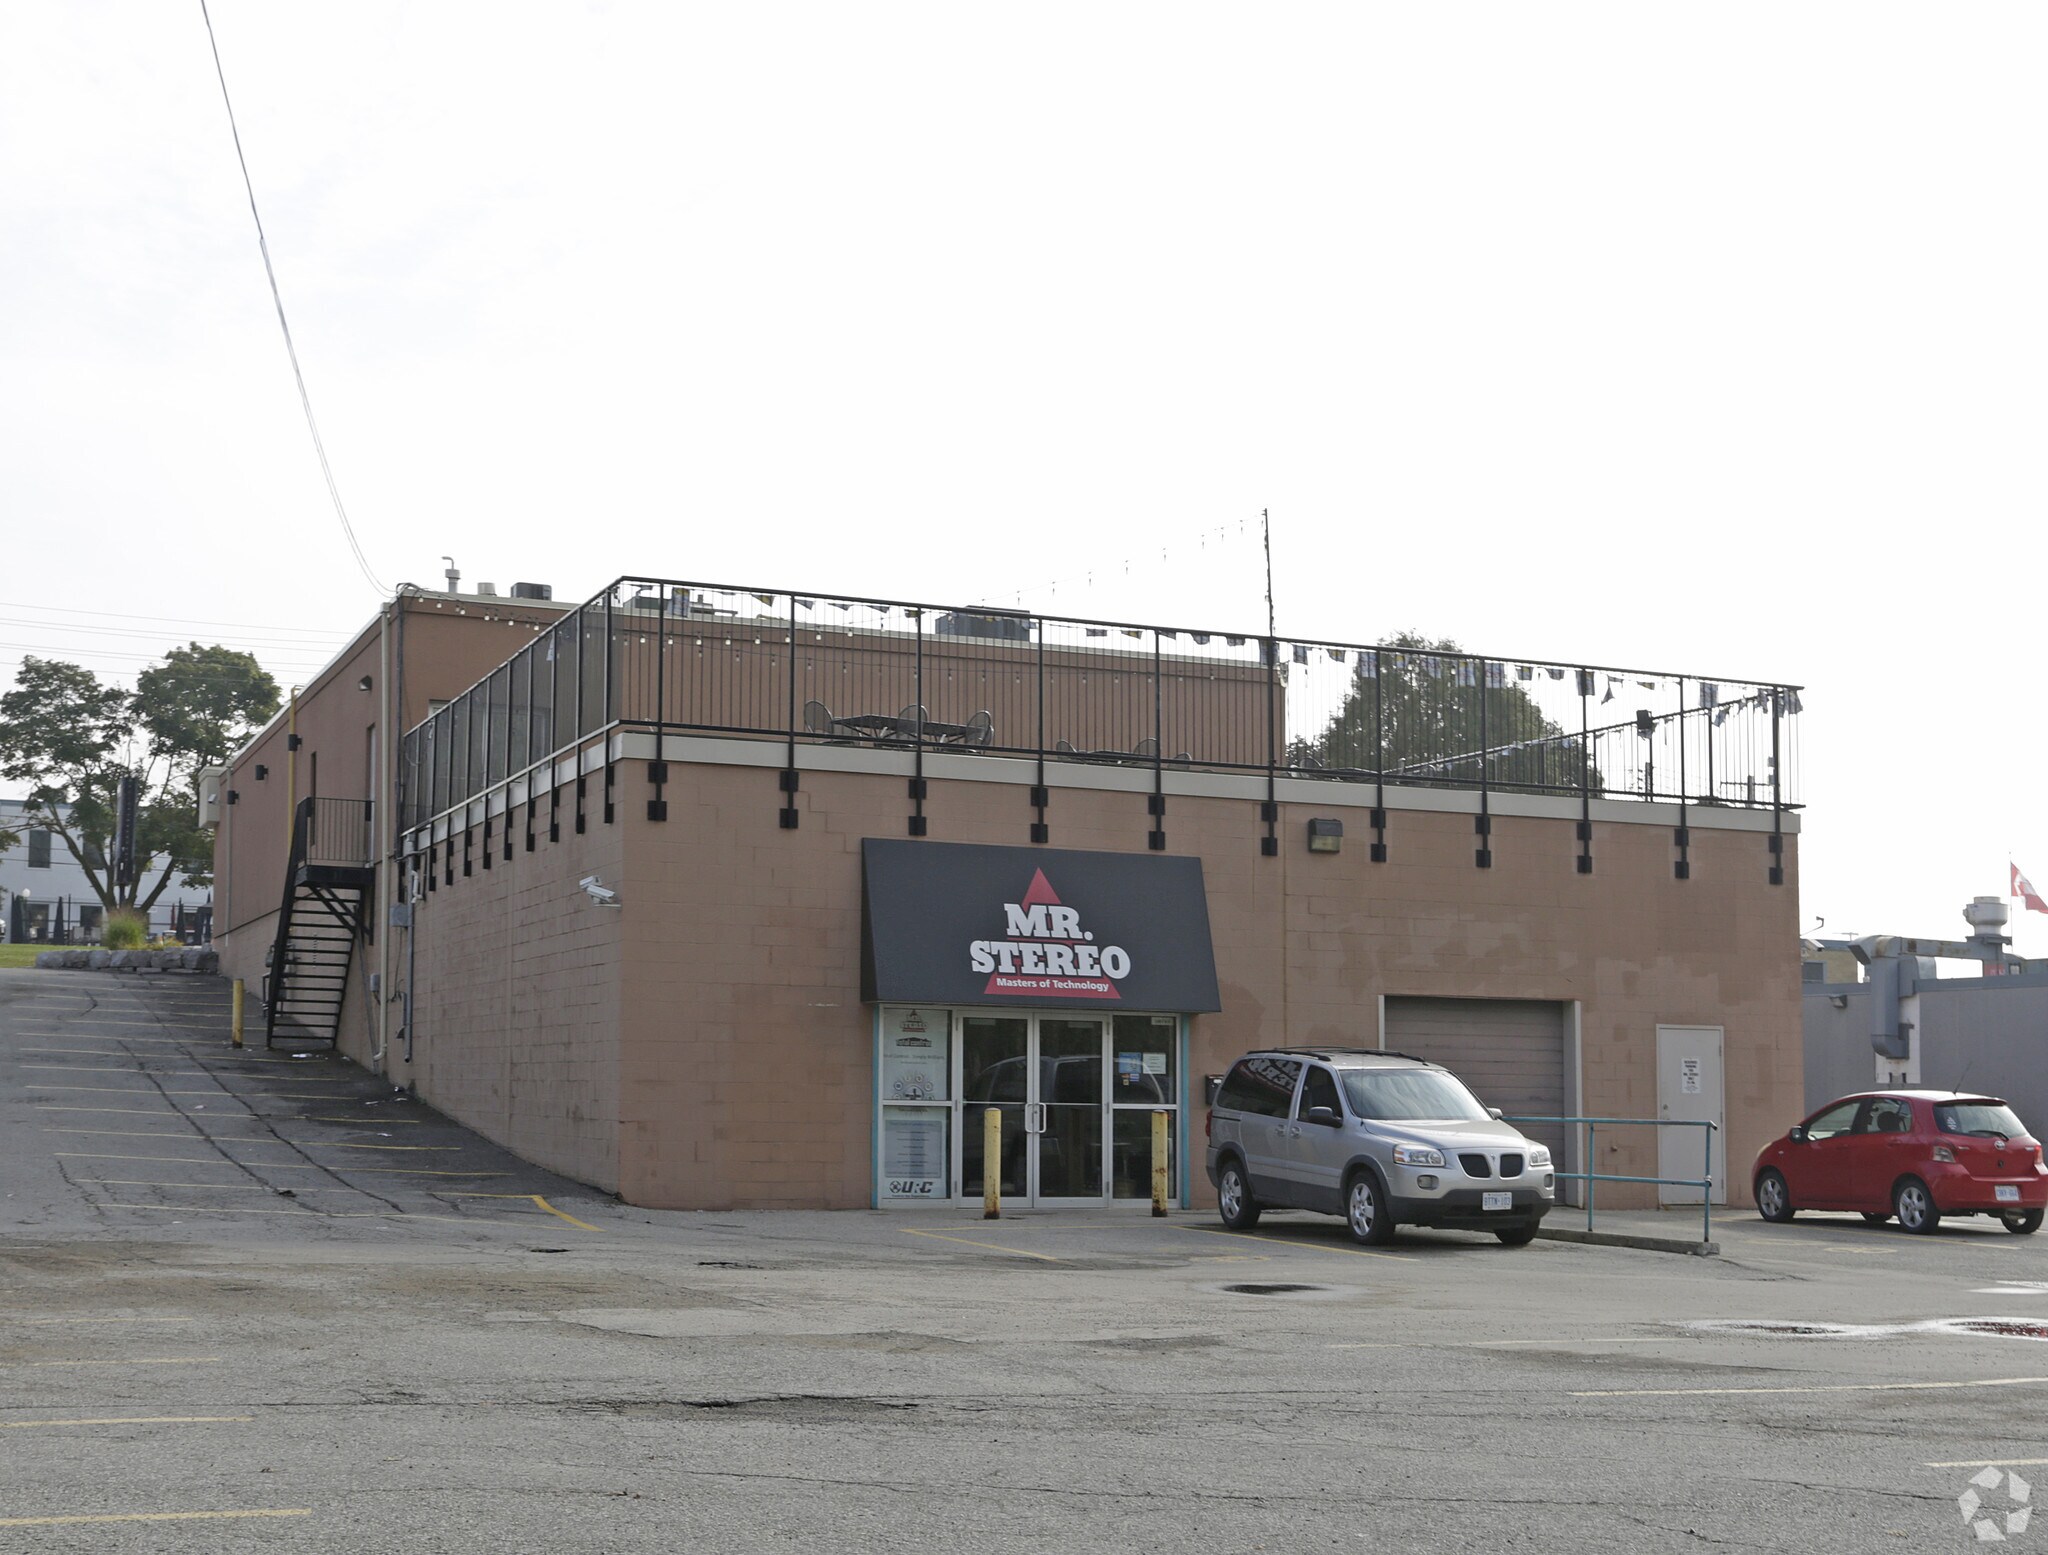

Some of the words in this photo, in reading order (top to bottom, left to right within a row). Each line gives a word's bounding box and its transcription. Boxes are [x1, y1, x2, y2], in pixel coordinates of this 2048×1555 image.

[1003, 903, 1094, 941] MR.
[970, 940, 1131, 980] STEREO
[996, 978, 1037, 988] Masters
[1039, 979, 1050, 988] of
[1052, 980, 1109, 992] Technology
